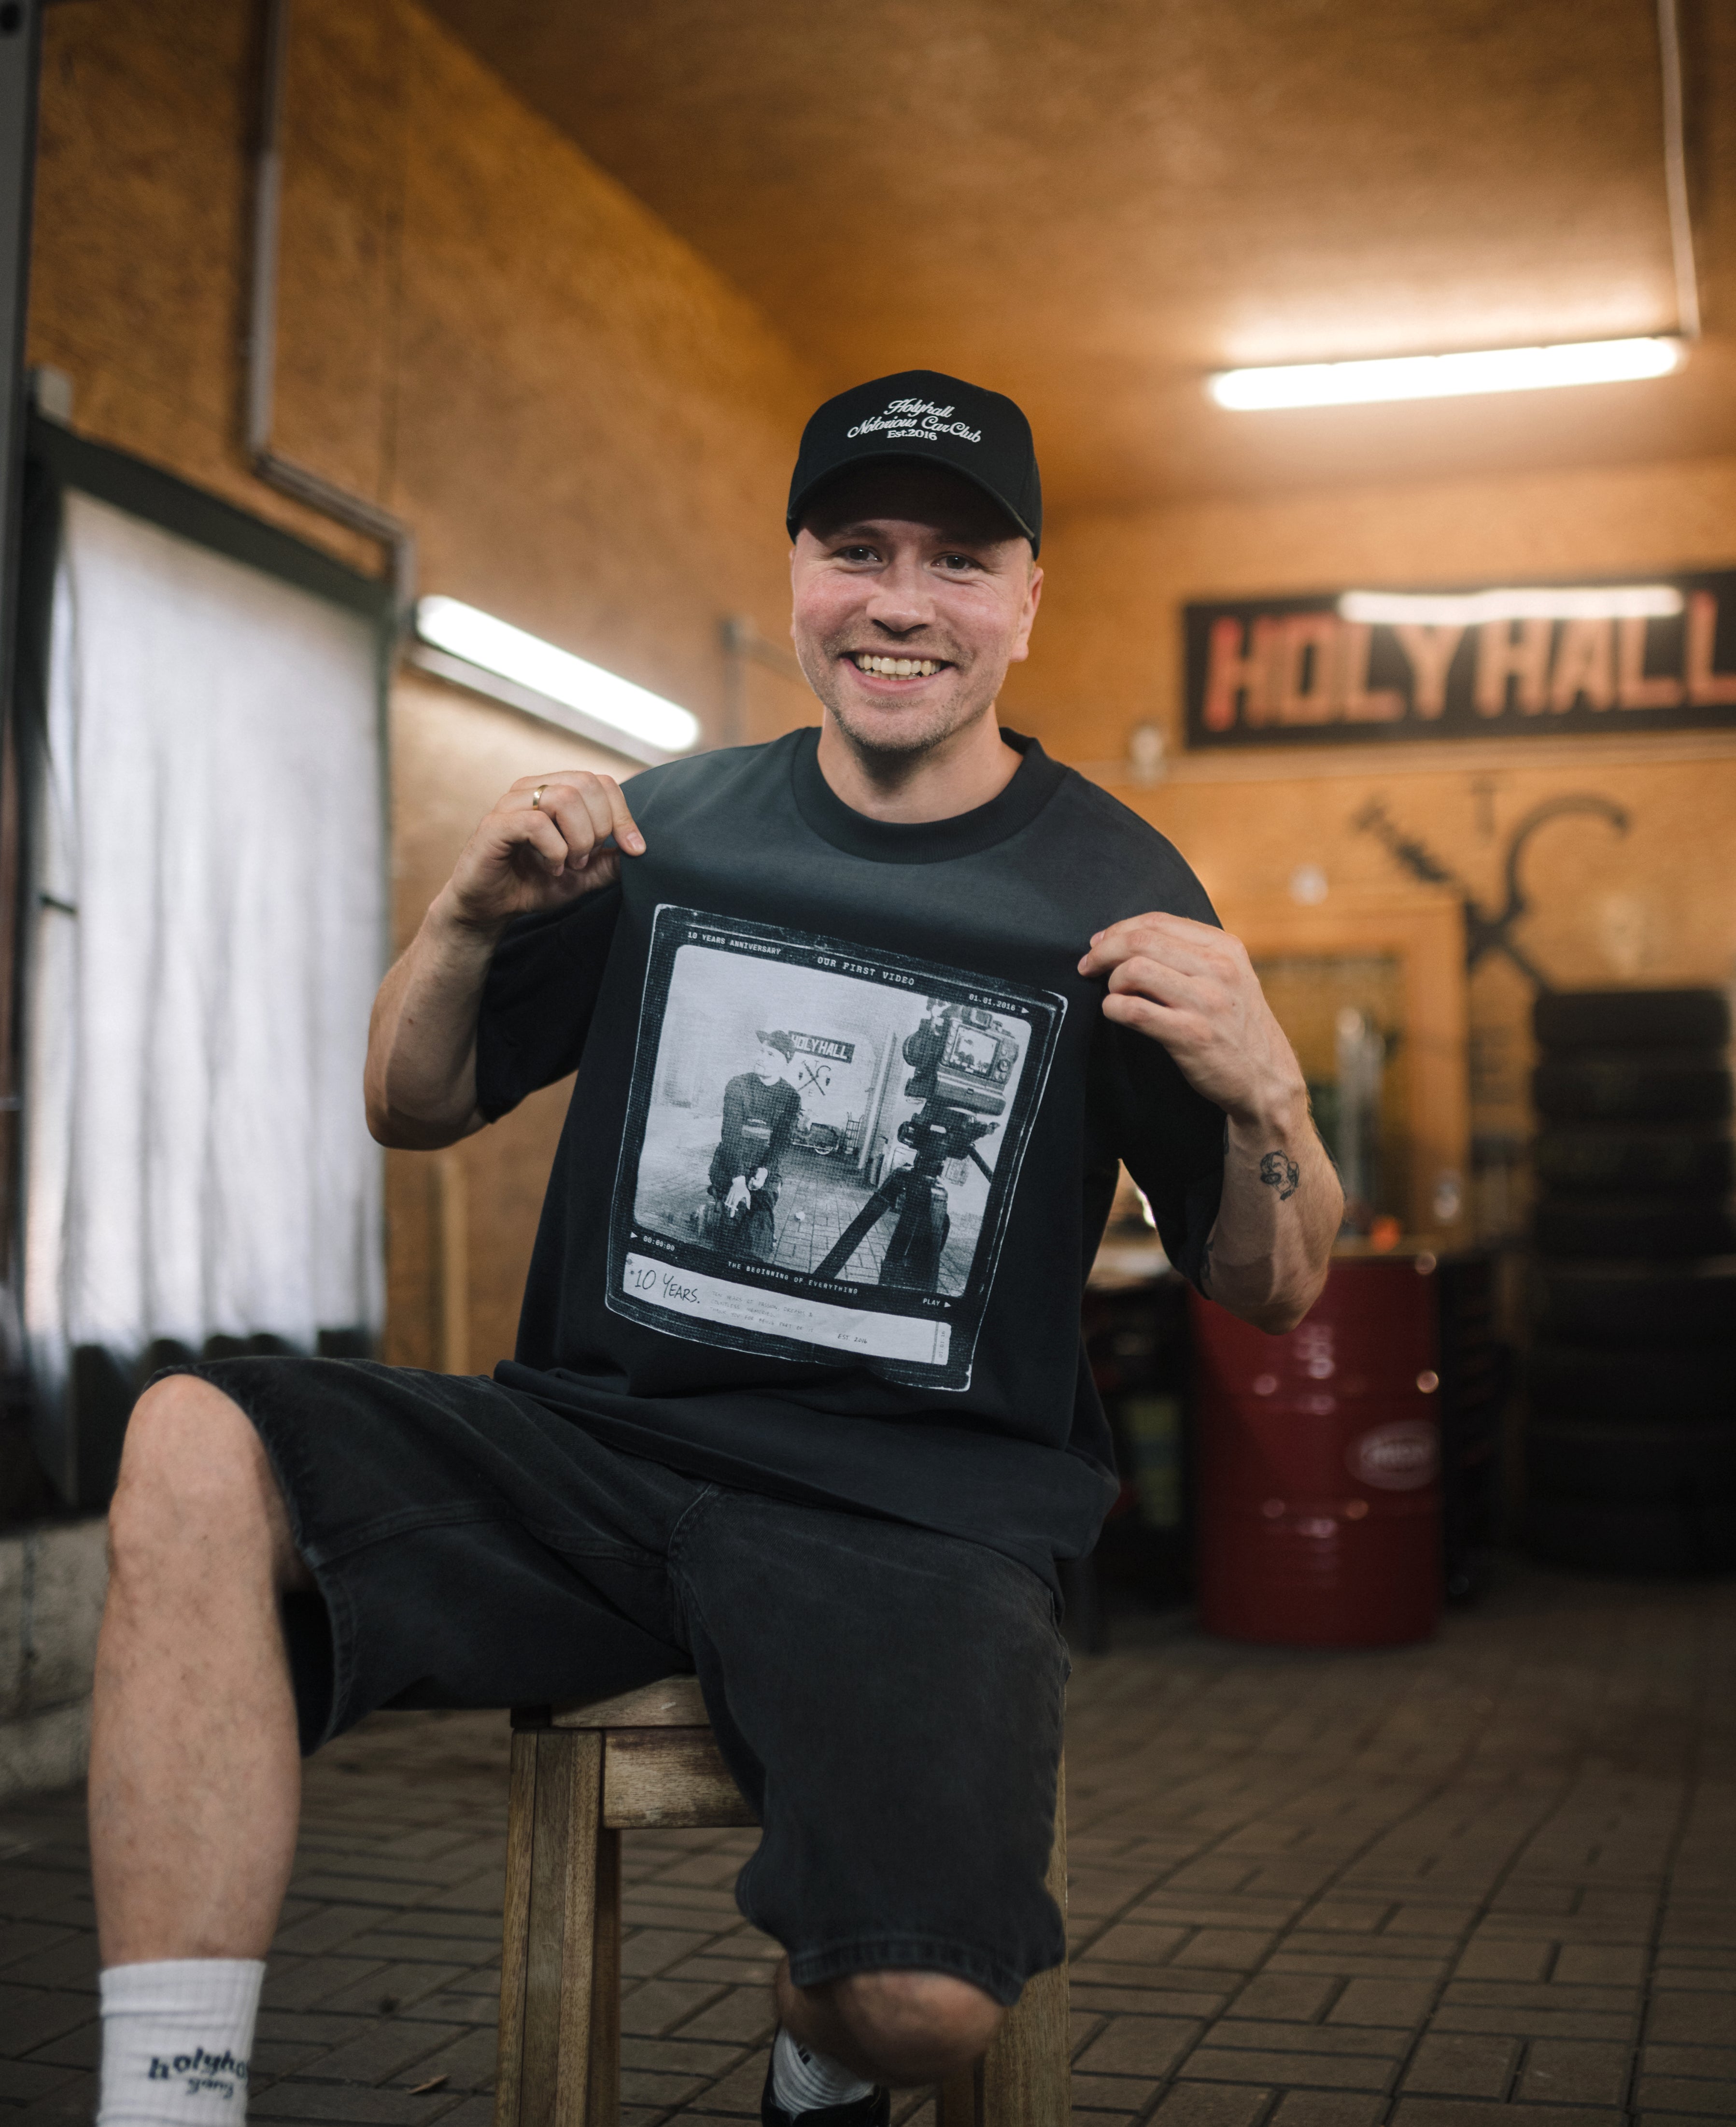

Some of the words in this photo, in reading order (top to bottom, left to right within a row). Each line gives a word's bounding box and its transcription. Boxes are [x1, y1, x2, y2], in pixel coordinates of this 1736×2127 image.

[883, 398, 955, 418] Holyhall
[847, 416, 917, 438] Notorious
[887, 429, 938, 441] Est.2016
[688, 931, 698, 939] 10
[702, 934, 726, 944] YEARS
[729, 941, 781, 955] ANNIVERSARY
[817, 956, 837, 967] OUR
[842, 962, 876, 976] FIRST
[882, 971, 915, 986] VIDEO
[969, 993, 1016, 1011] 01.01.2016
[635, 1269, 656, 1290] 10
[728, 1261, 741, 1270] THE
[746, 1266, 789, 1280] BEGINNING
[808, 1280, 858, 1294] EVERYTHING
[923, 1298, 941, 1306] PLAY
